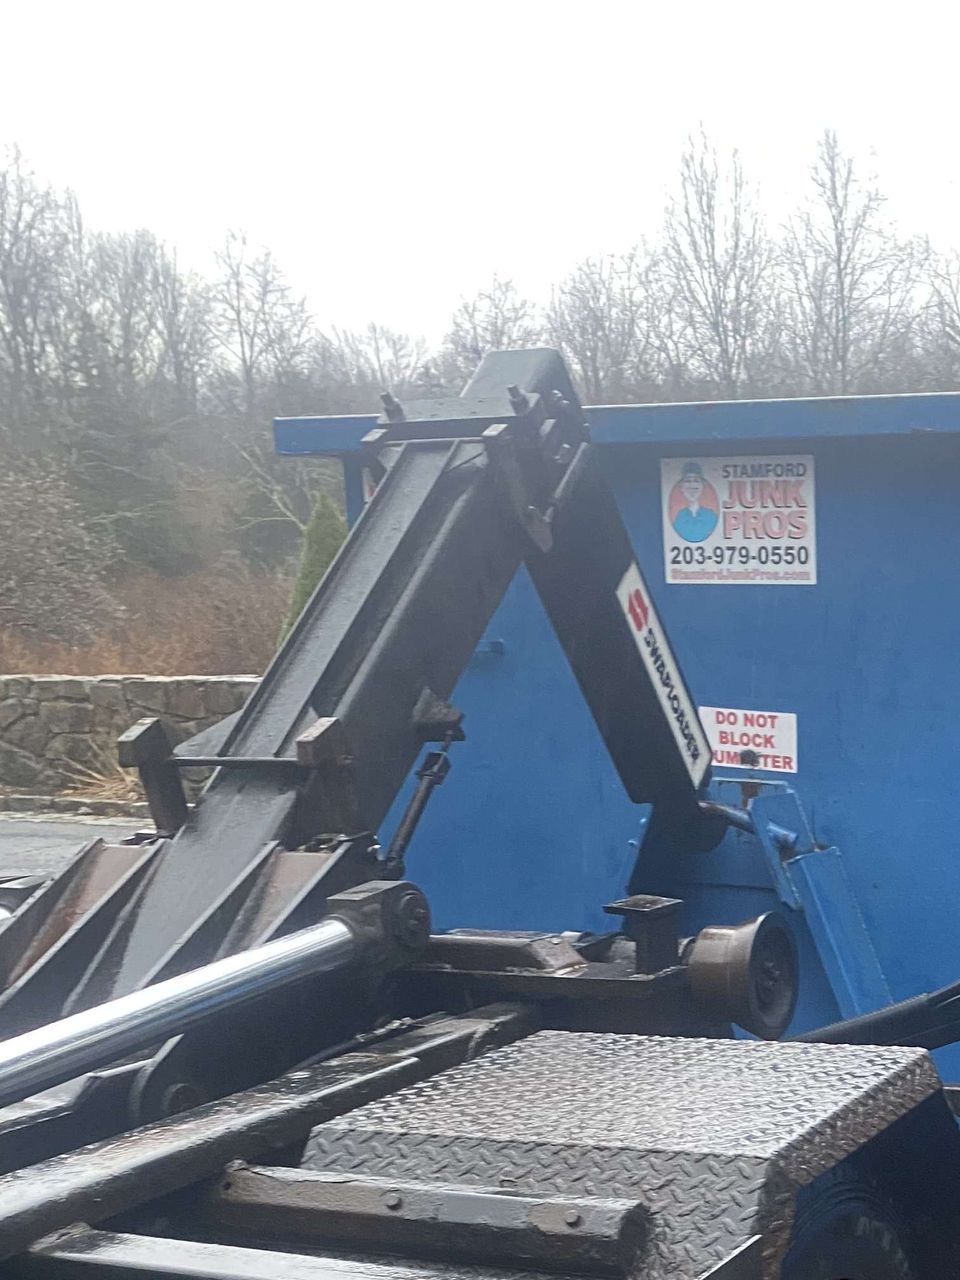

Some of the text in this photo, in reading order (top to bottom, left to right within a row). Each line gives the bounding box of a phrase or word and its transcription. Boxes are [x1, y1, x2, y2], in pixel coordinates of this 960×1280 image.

[722, 463, 807, 478] STAMFORD
[722, 480, 808, 509] JUNK
[722, 510, 808, 539] PROS
[670, 546, 809, 565] 203-979-0550
[643, 627, 699, 761] SWAPLOADER
[715, 710, 778, 729] DO NOT
[719, 730, 775, 748] BLOCK
[712, 749, 793, 770] UMTER
